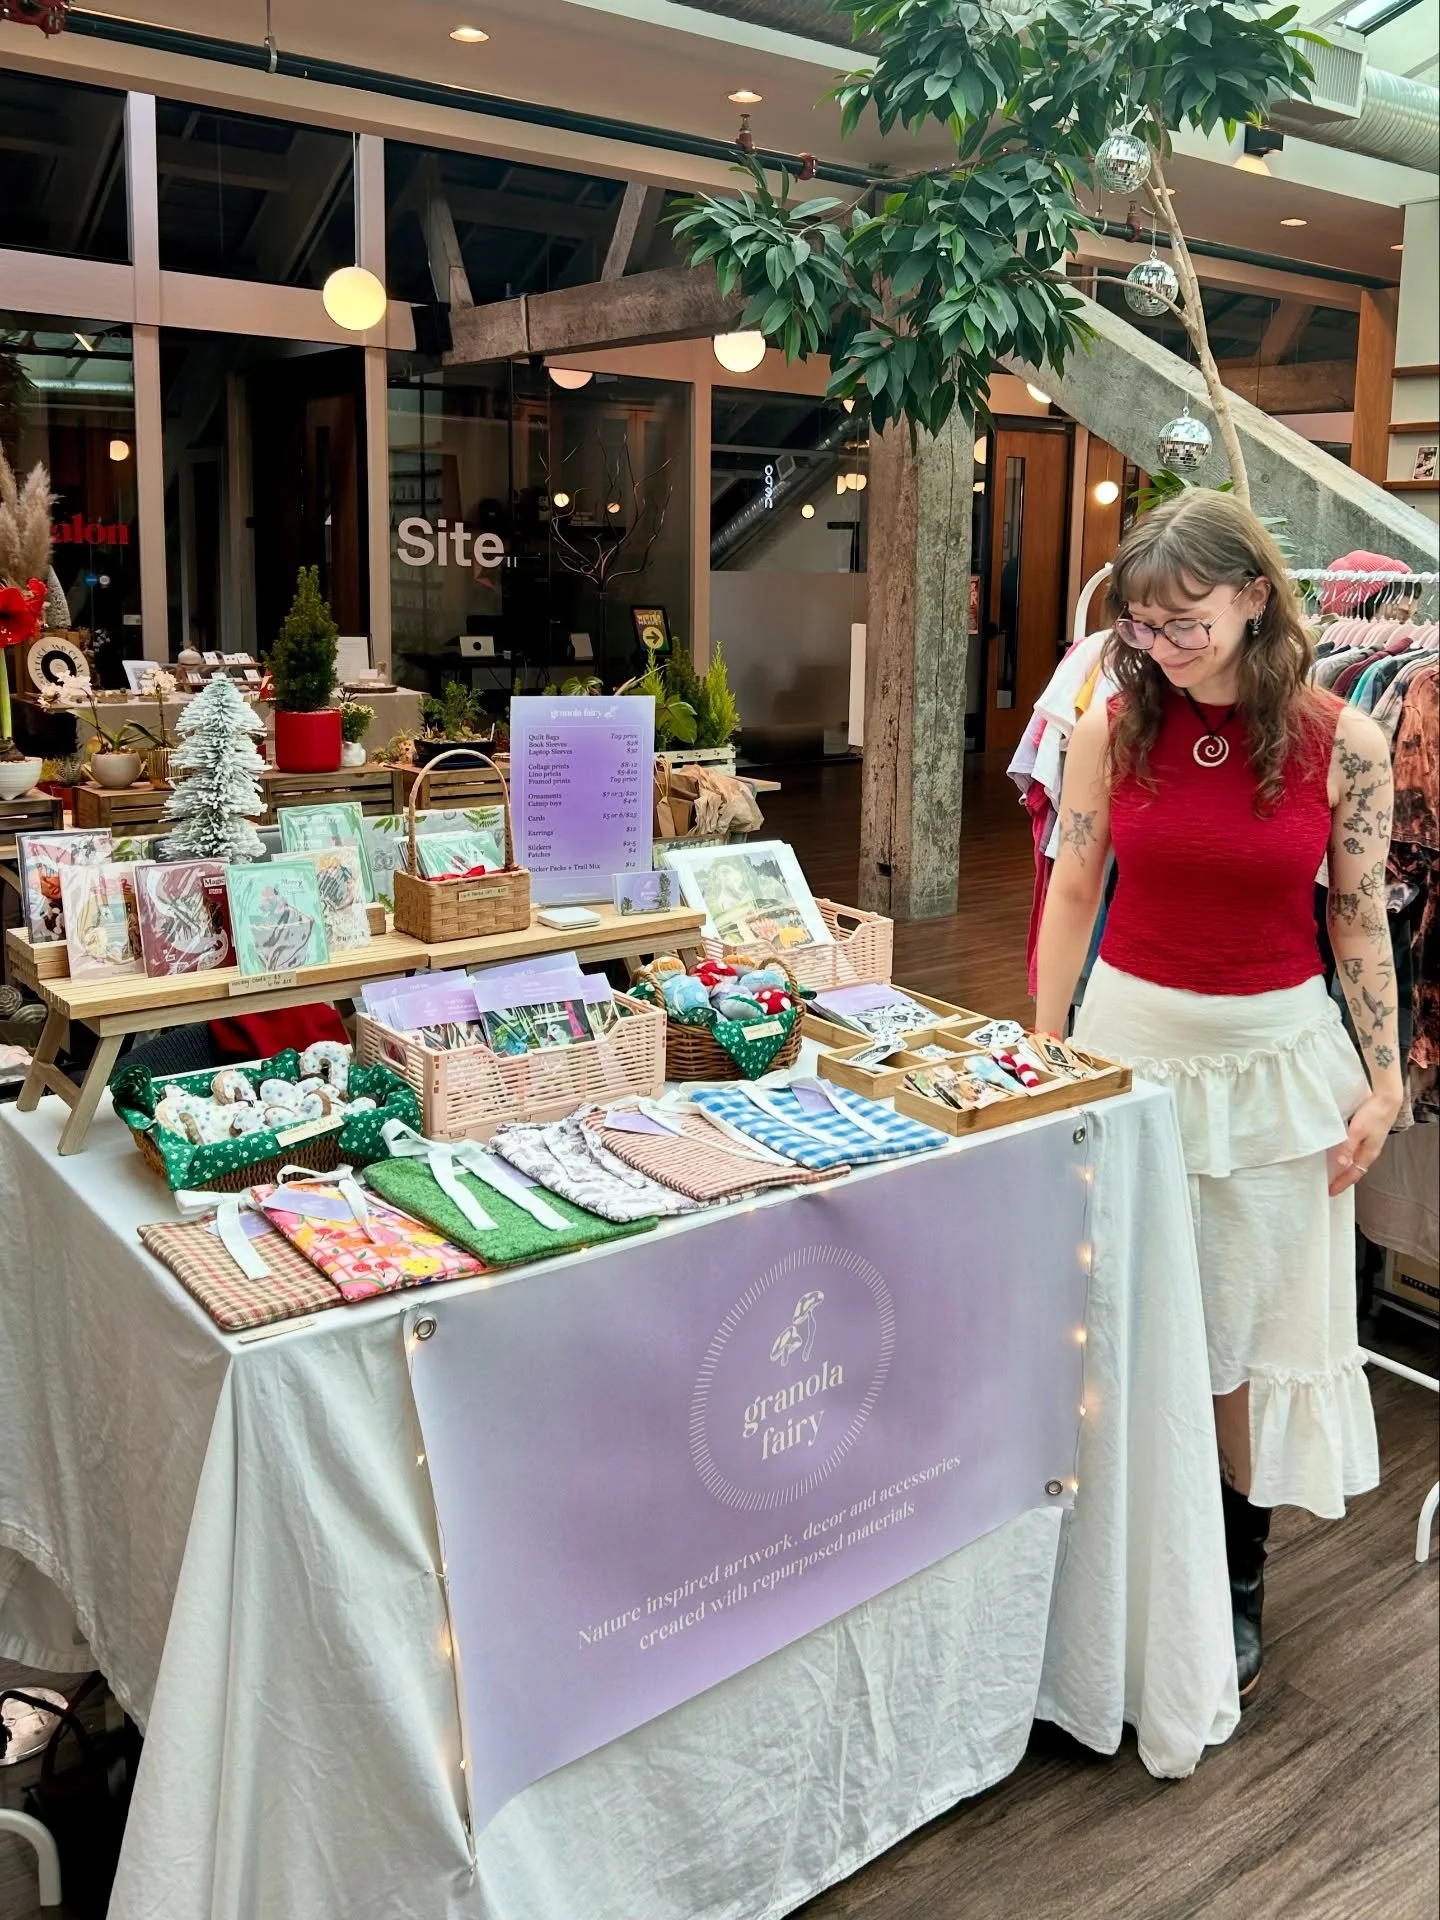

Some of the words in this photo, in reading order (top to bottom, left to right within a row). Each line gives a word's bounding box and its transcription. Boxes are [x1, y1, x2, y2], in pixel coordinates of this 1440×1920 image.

[742, 1360, 845, 1438] granola
[761, 1409, 825, 1461] fairy
[577, 1606, 642, 1650] Nature
[646, 1565, 720, 1616] inspired
[803, 1508, 847, 1541] decor
[850, 1489, 877, 1518] and
[879, 1454, 961, 1503] accessories
[639, 1601, 705, 1650] created
[709, 1583, 749, 1614] with
[752, 1533, 843, 1594] repurposed
[847, 1501, 915, 1546] materials
